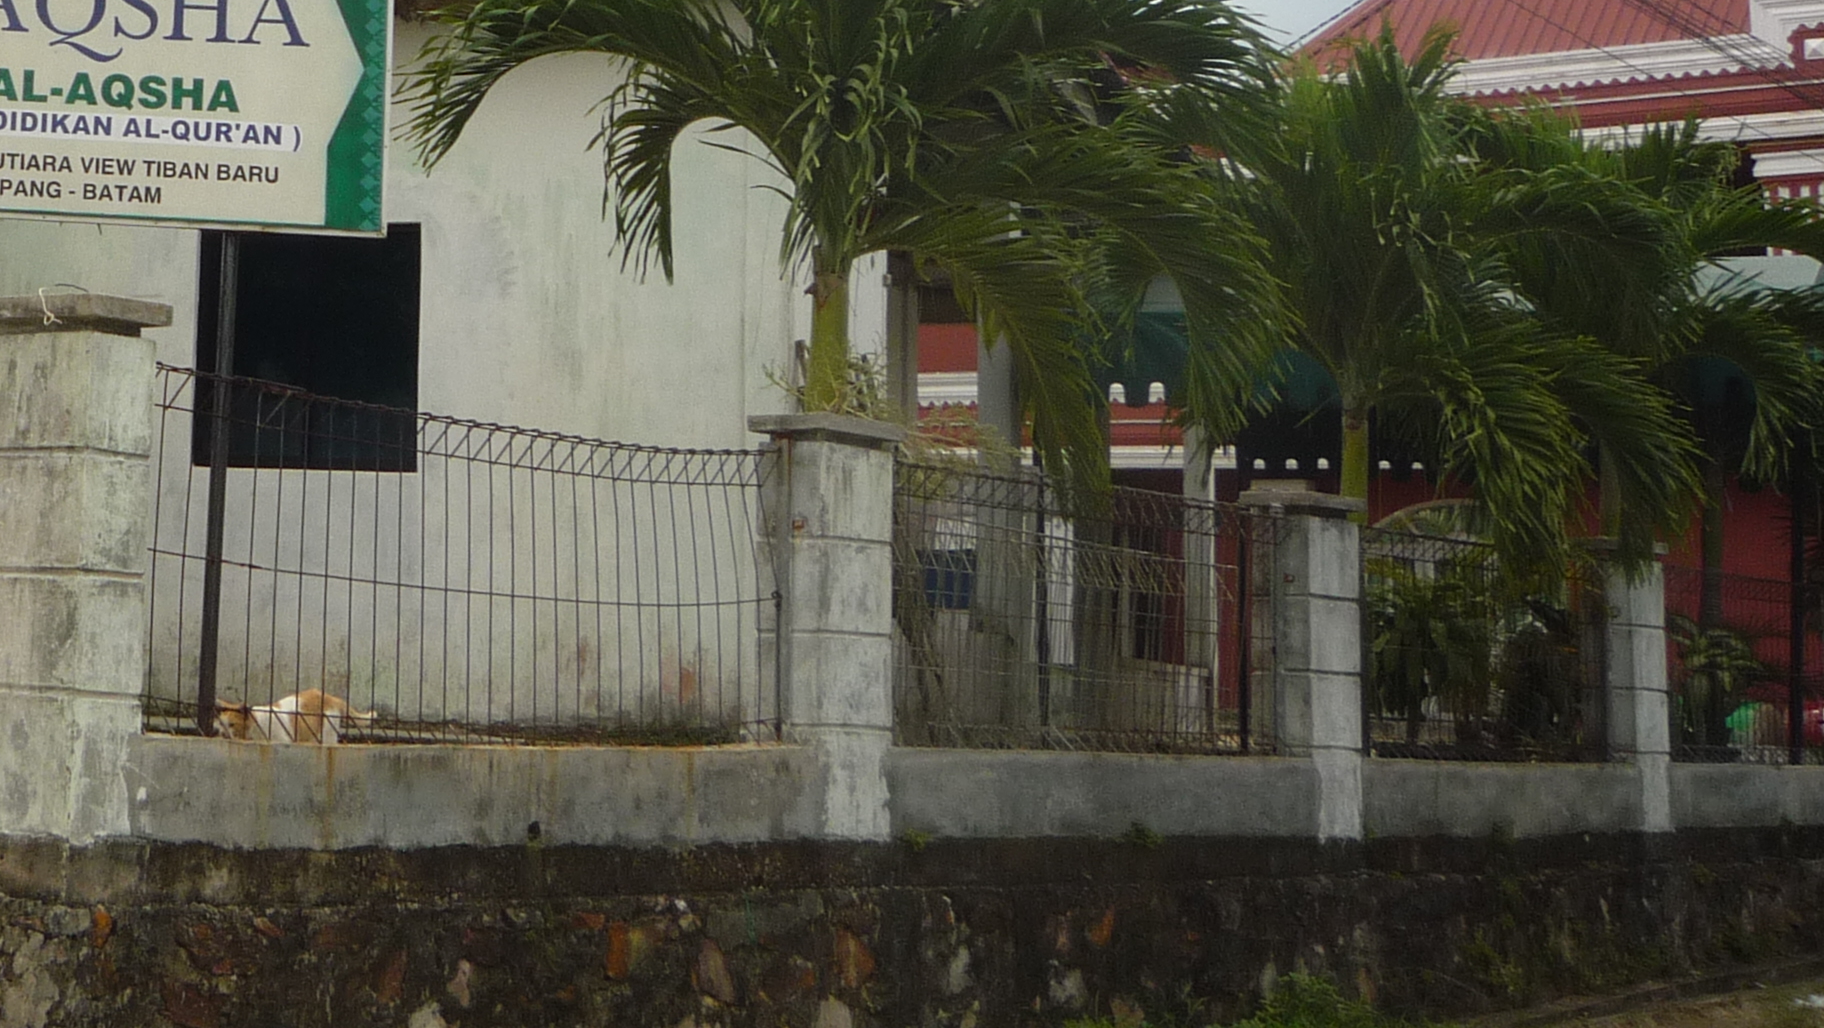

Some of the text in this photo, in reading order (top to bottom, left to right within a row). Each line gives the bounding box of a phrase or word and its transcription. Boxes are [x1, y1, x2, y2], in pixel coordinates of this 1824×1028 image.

[122, 117, 283, 146] AL-QUR'AN
[80, 156, 137, 177] VIEW
[142, 160, 210, 181] TIBAN
[216, 164, 280, 184] BARU
[82, 183, 162, 204] BATAM
